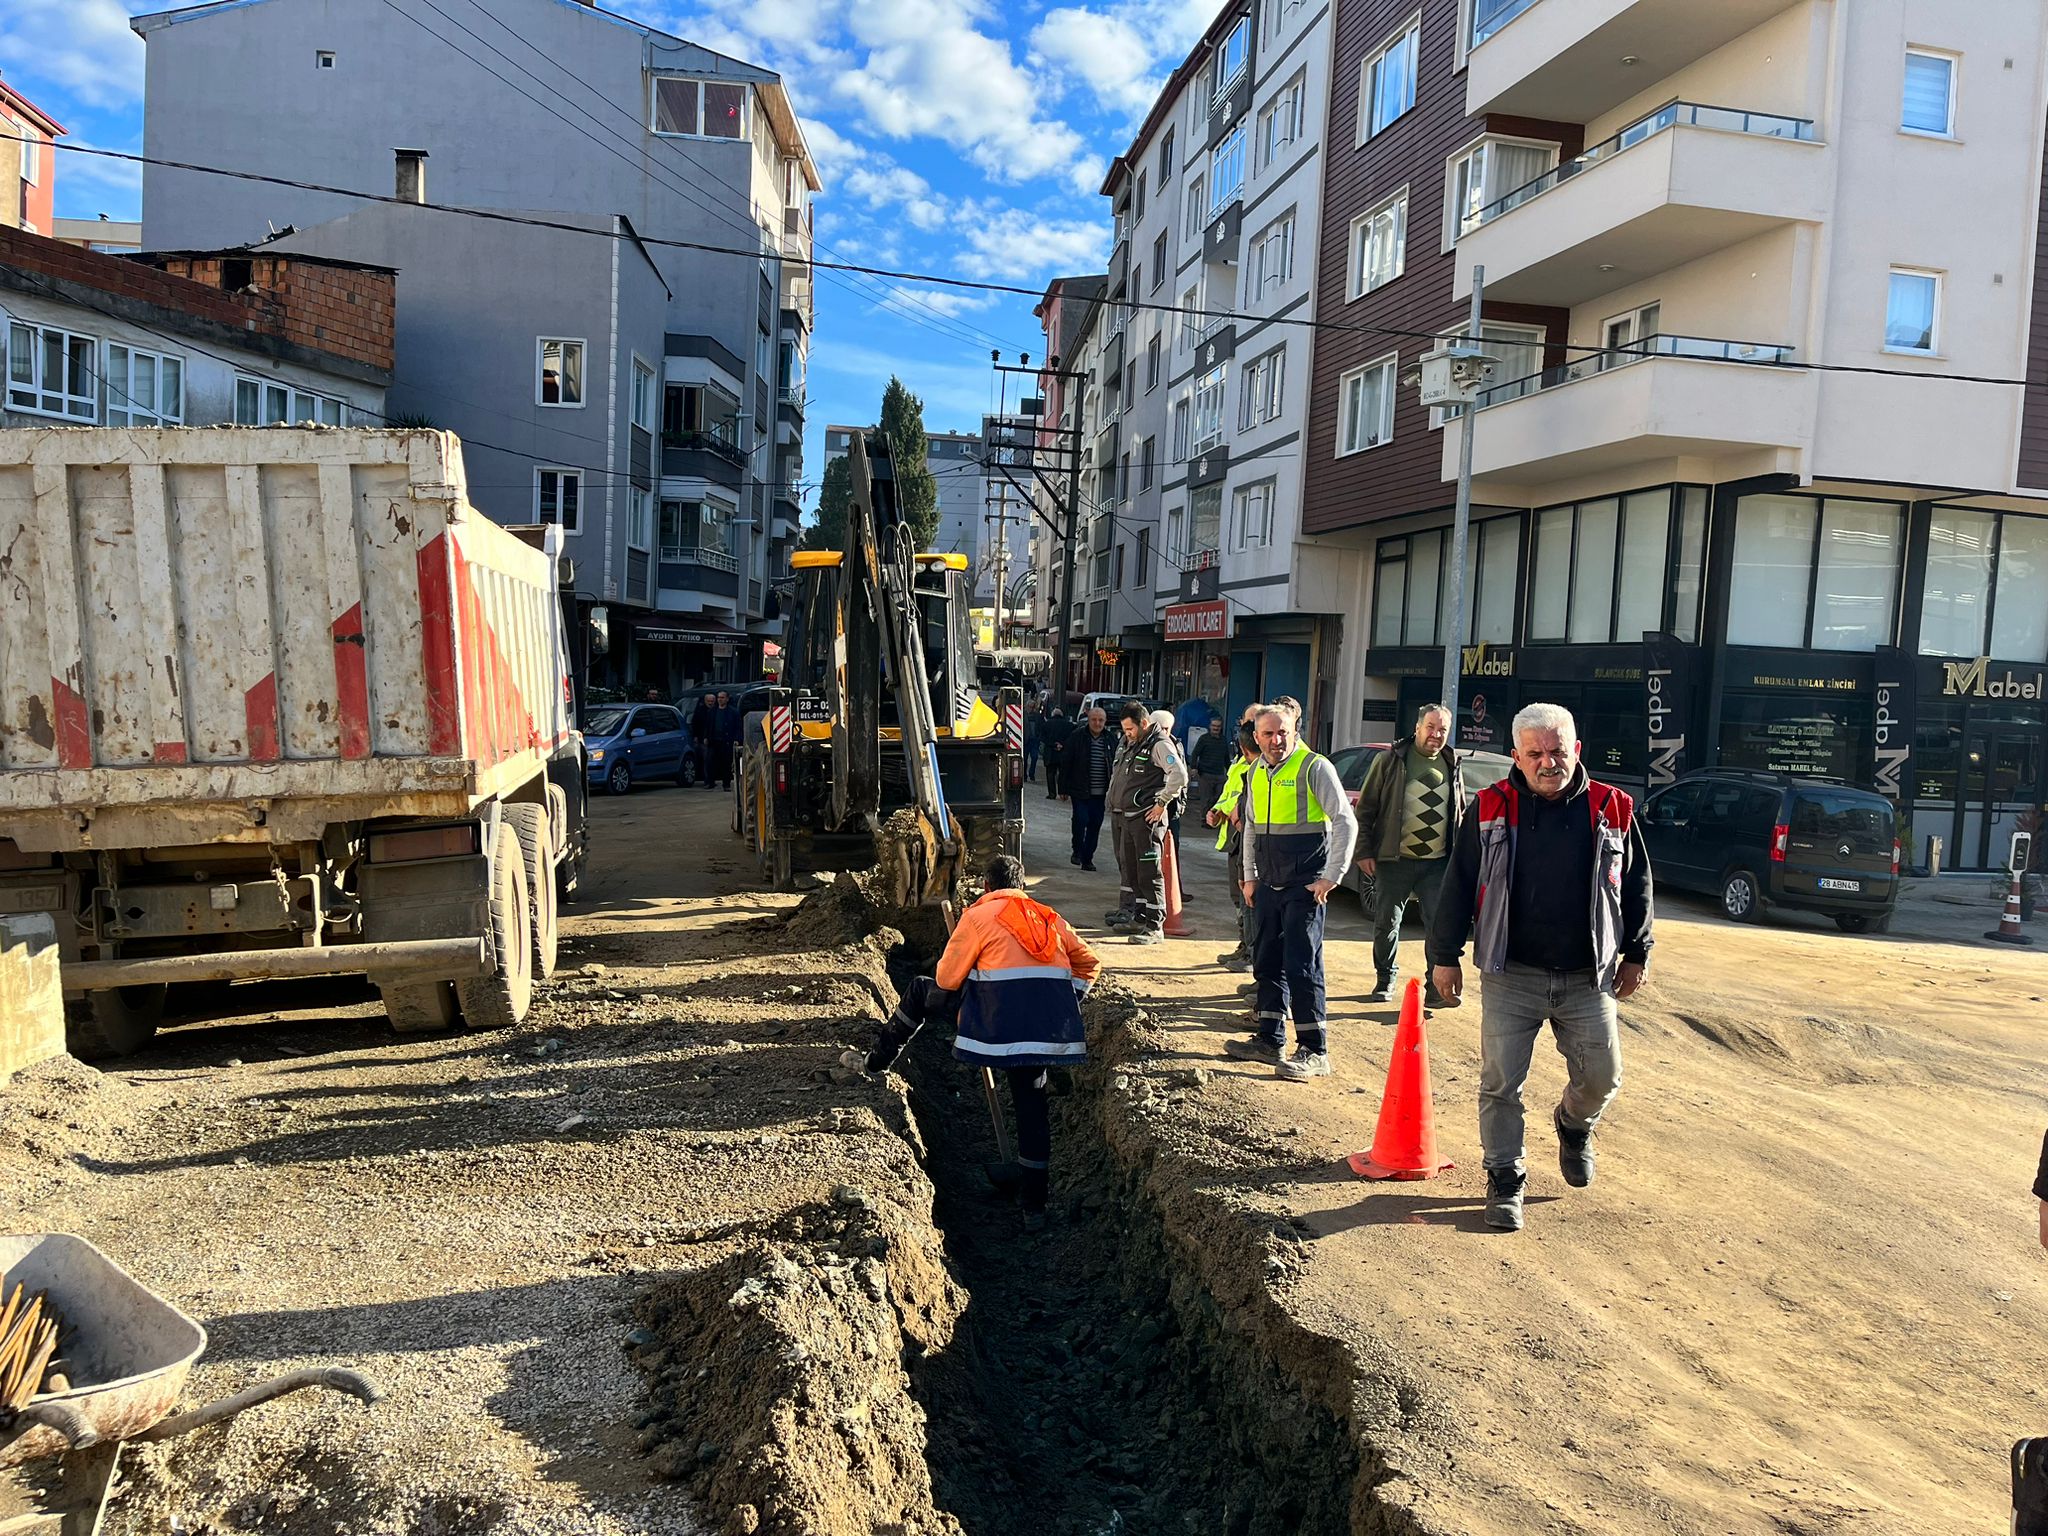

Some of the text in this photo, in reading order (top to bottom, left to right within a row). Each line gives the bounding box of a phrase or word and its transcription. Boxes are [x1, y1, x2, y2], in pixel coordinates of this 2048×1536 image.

[1167, 606, 1222, 633] ERDOĞAN TİCARET
[647, 632, 673, 640] AYDIN
[1461, 639, 1514, 676] Mabel
[1753, 676, 1856, 690] KURUMSAL EMLAK ZİNCİRİ
[1943, 655, 2043, 699] Mabel
[800, 701, 811, 710] 28
[1648, 669, 1685, 788] Mabel
[1874, 682, 1909, 799] Mabel
